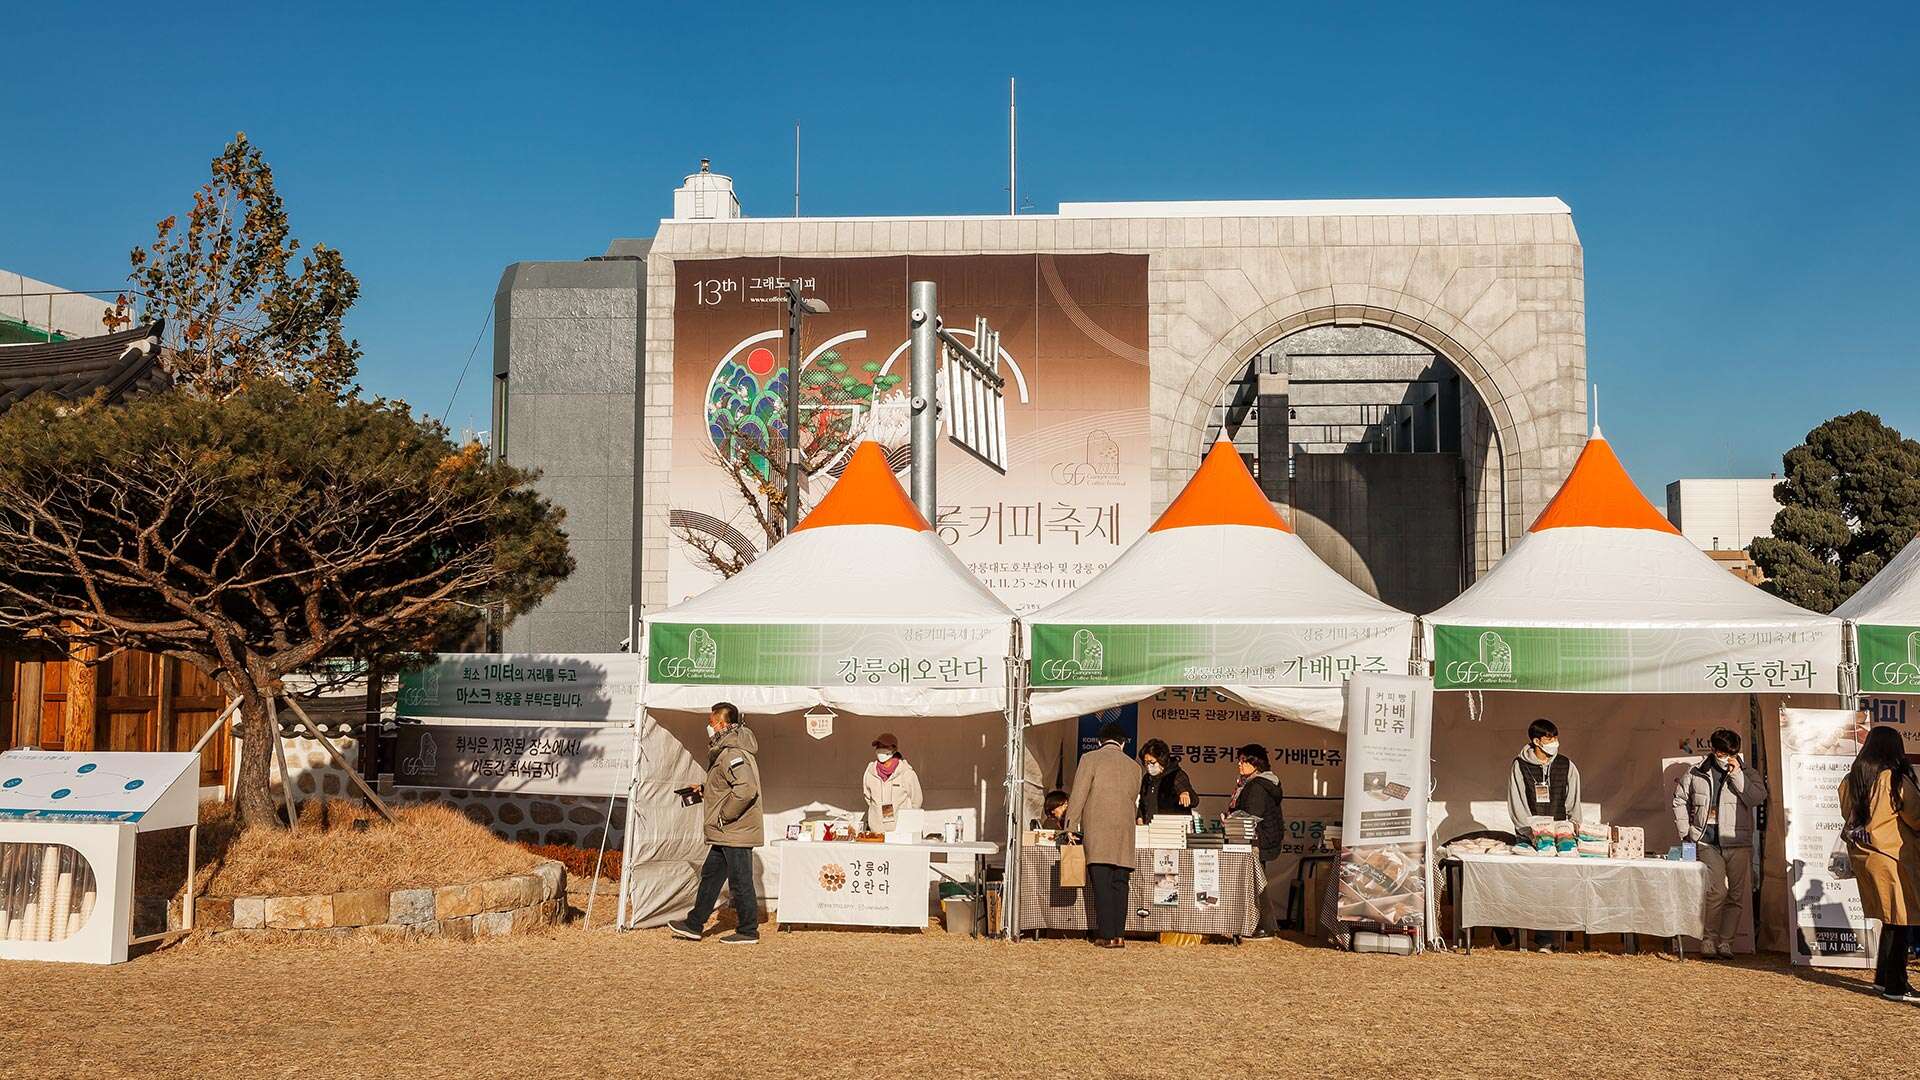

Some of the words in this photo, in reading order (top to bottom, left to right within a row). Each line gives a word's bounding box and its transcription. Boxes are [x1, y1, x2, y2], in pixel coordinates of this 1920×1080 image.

[693, 278, 737, 305] 13th
[937, 502, 1120, 546] 릉커피축제
[463, 667, 480, 681] 최소
[484, 663, 525, 682] 1미터의
[527, 668, 555, 682] 거리를
[558, 668, 577, 682] 두고
[836, 656, 988, 684] 강릉애오란다
[1703, 659, 1818, 689] 경동한과
[456, 686, 492, 705] 마스크
[495, 692, 522, 706] 착용을
[525, 692, 583, 708] 부탁드립니다.
[1151, 708, 1201, 721] (대한민국
[1204, 708, 1262, 722] 관광기념품
[1375, 703, 1406, 719] 가배
[1374, 718, 1405, 734] 만쥬
[456, 736, 488, 753] 취식은
[491, 738, 526, 755] 지정된
[529, 739, 581, 757] 장소에서!
[1274, 747, 1344, 768] 가배만쥬
[508, 760, 560, 779] 취식금지!
[849, 860, 890, 877] 강릉애
[850, 879, 890, 895] 오란다
[1829, 942, 1838, 952] 시
[1840, 932, 1857, 943] 이상
